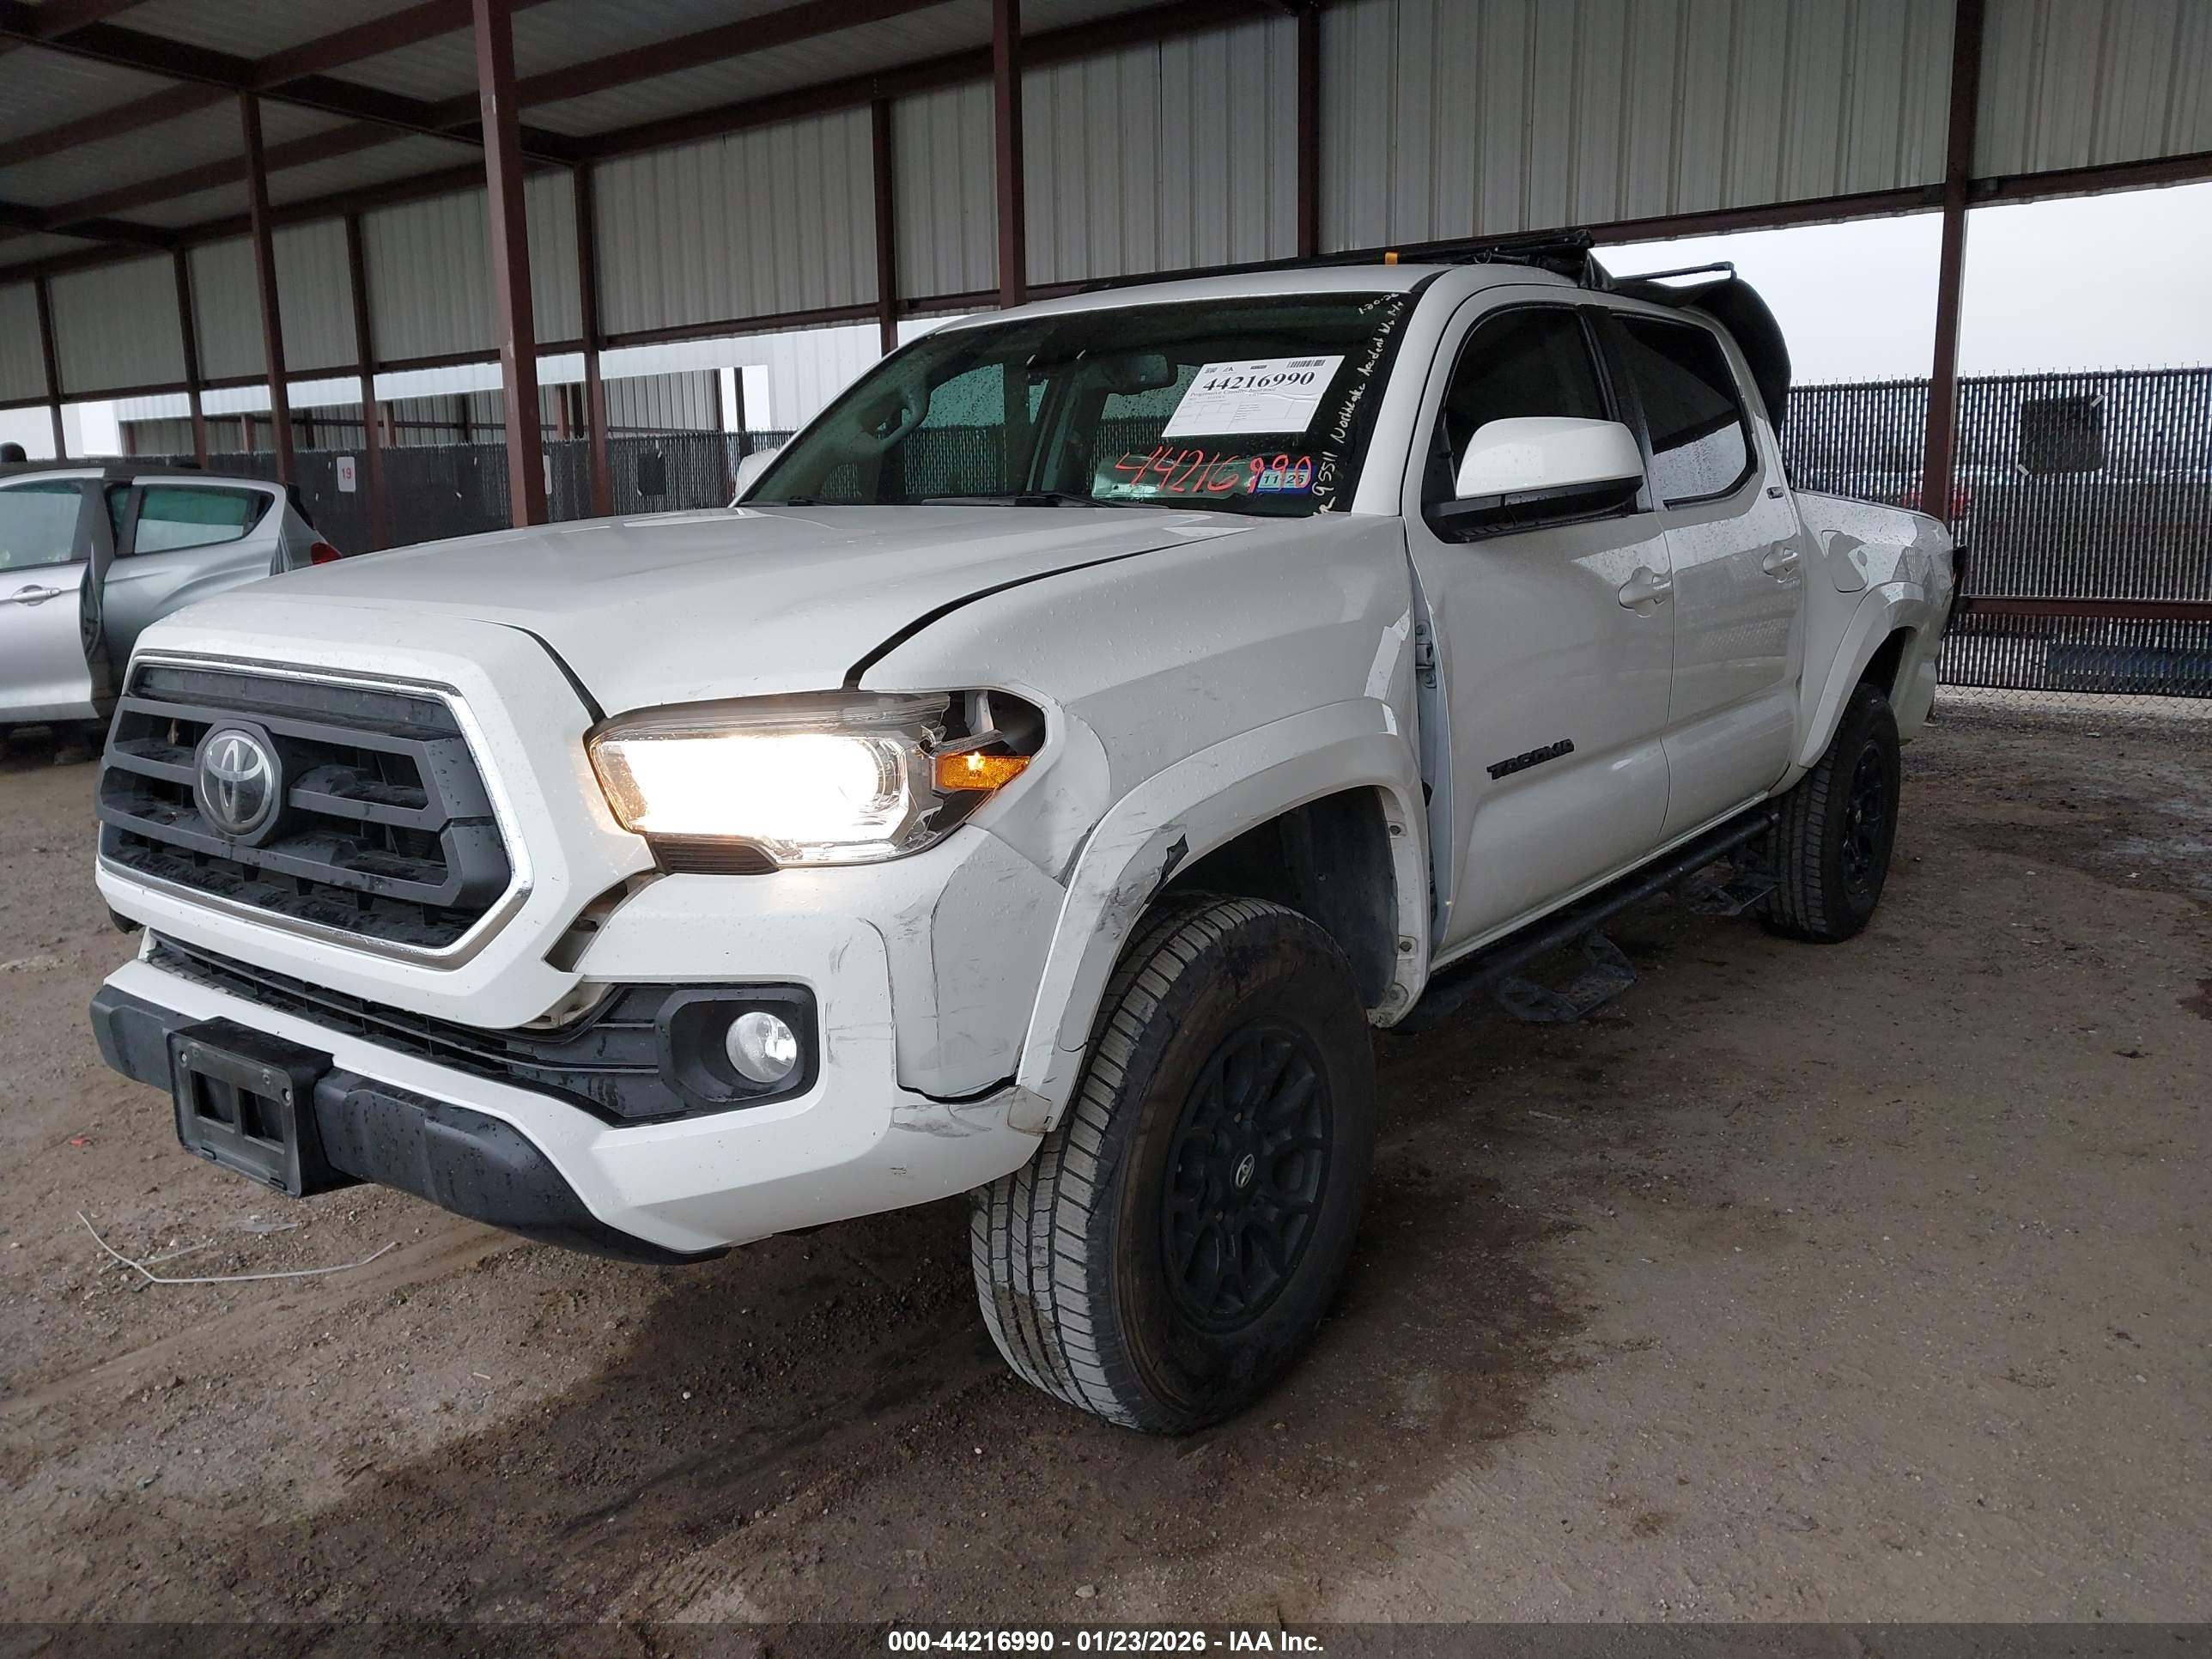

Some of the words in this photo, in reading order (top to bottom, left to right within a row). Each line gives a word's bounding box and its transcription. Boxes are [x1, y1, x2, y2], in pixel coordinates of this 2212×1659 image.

[1357, 337, 1384, 377] Accident
[1202, 371, 1316, 391] 44216990
[342, 467, 352, 479] 19
[1115, 446, 1312, 494] 44216990
[1264, 474, 1279, 483] 11
[1486, 738, 1575, 780] TACOMA
